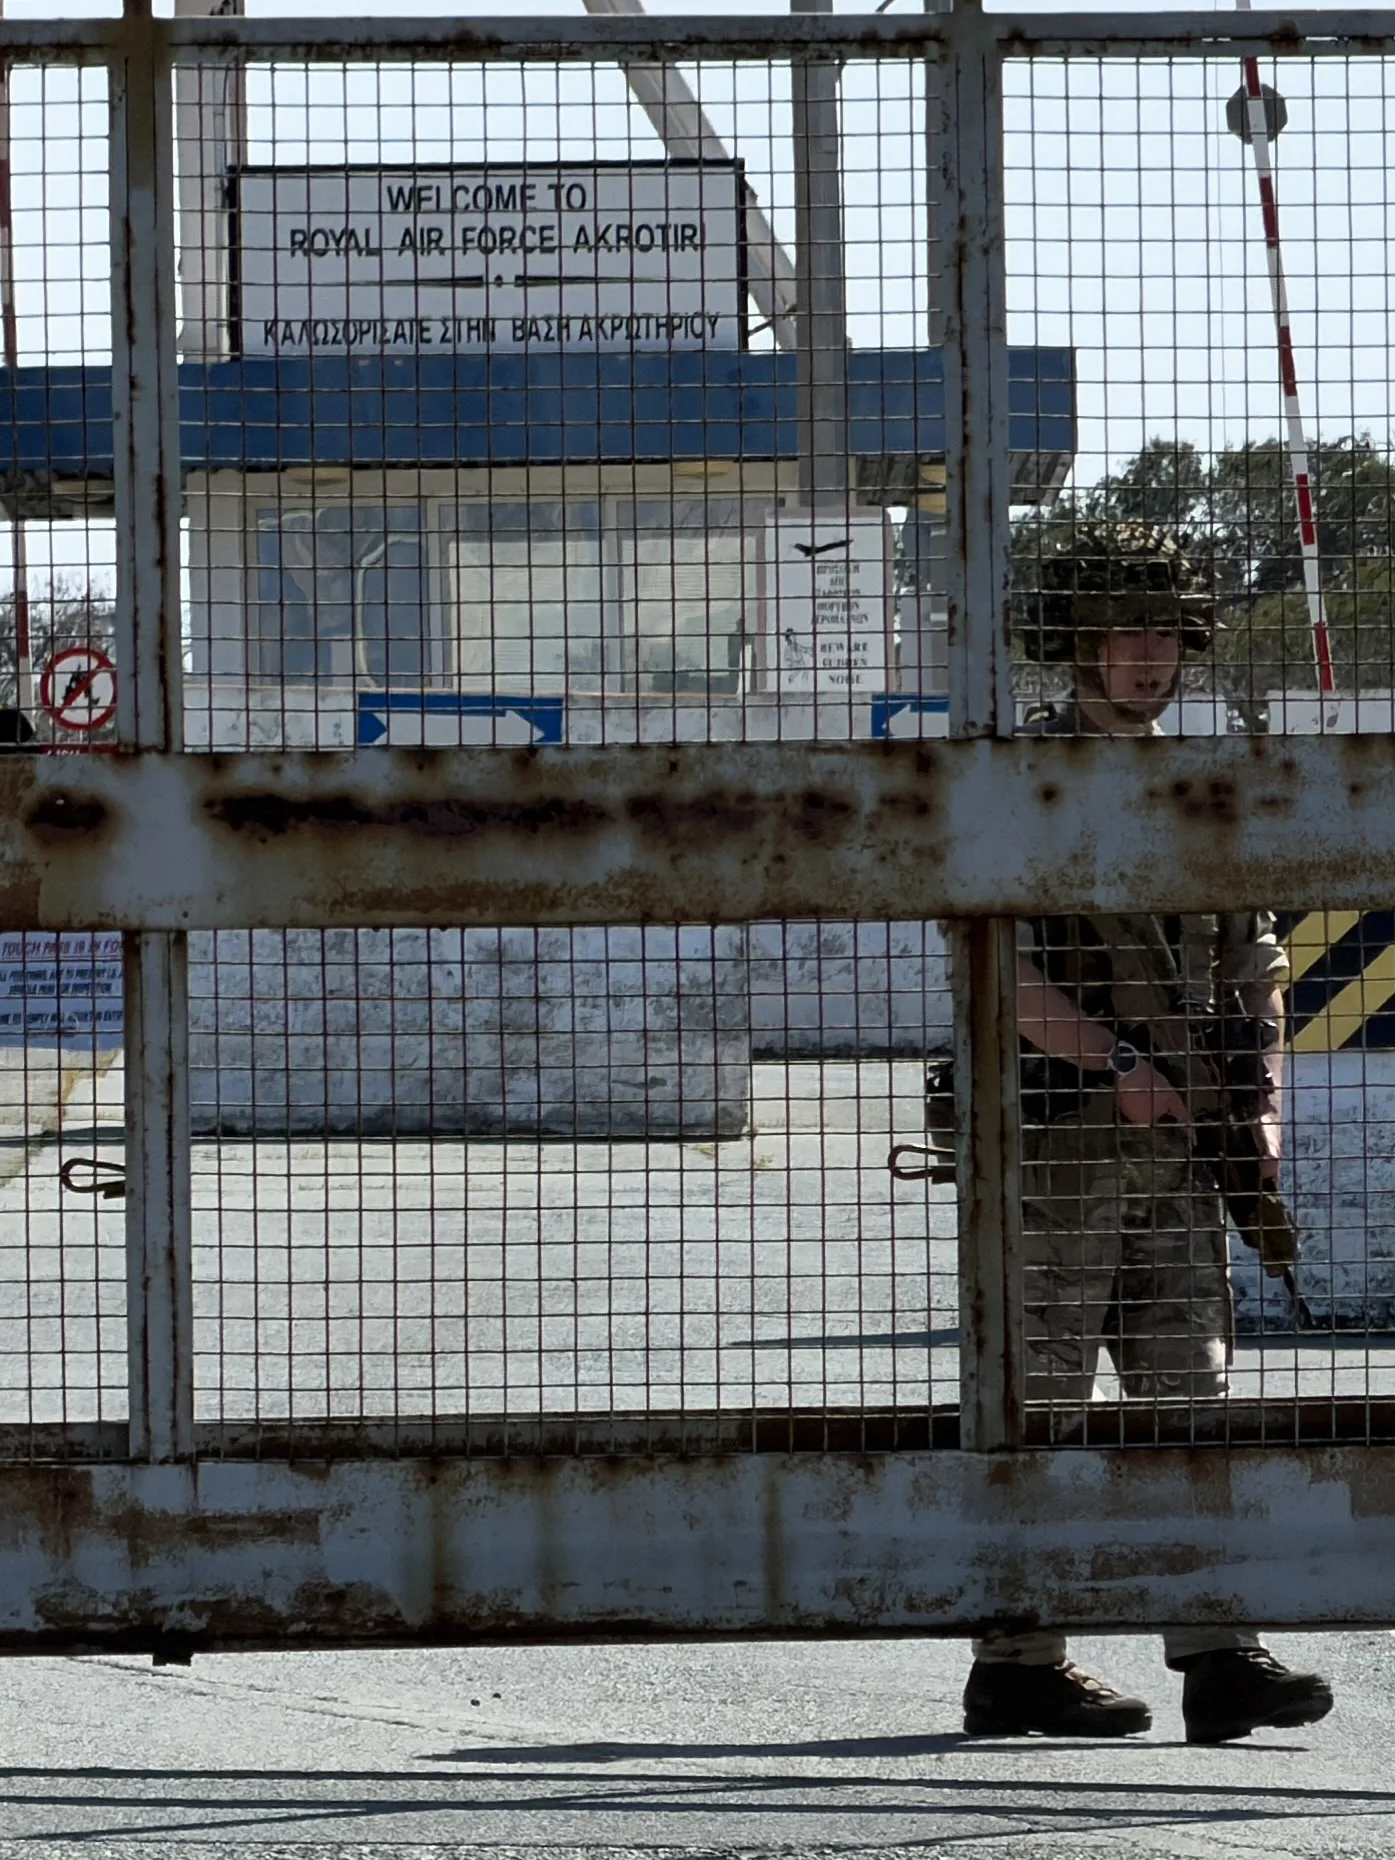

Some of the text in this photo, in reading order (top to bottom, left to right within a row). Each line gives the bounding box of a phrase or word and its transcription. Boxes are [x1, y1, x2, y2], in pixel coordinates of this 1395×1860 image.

[387, 183, 587, 211] WELCOME TO
[289, 227, 380, 257] ROYAL
[398, 226, 446, 257] AIR
[462, 224, 557, 256] FORCE
